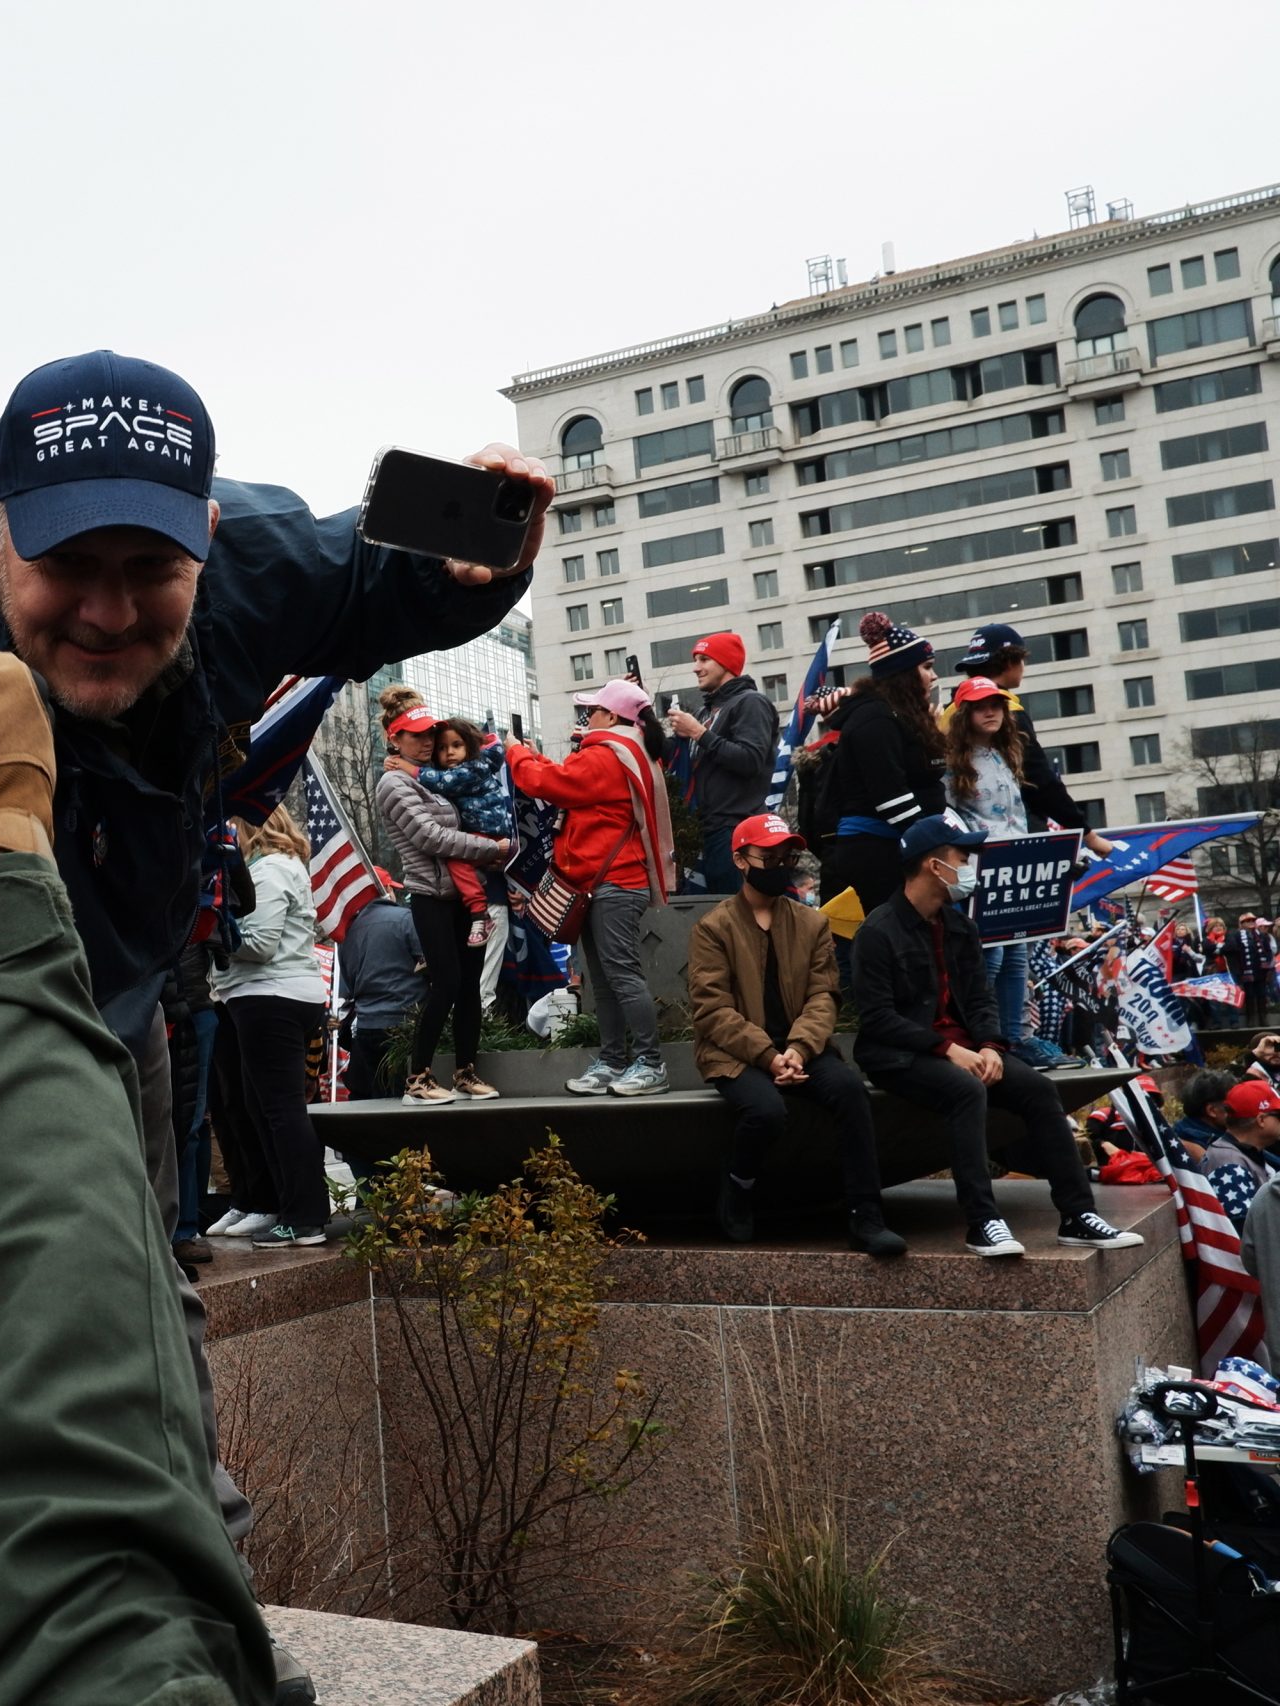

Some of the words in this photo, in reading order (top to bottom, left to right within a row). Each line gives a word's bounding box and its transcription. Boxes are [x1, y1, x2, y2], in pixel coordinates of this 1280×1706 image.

[82, 396, 148, 411] MAKE
[33, 411, 193, 450] SPACE
[36, 435, 108, 462] GREAT
[127, 437, 192, 467] AGAIN
[981, 860, 1071, 888] TRUMP
[987, 884, 1060, 905] PENCE
[982, 909, 998, 917] MAKE
[999, 906, 1024, 914] AMERICA
[1025, 903, 1042, 911] GREAT
